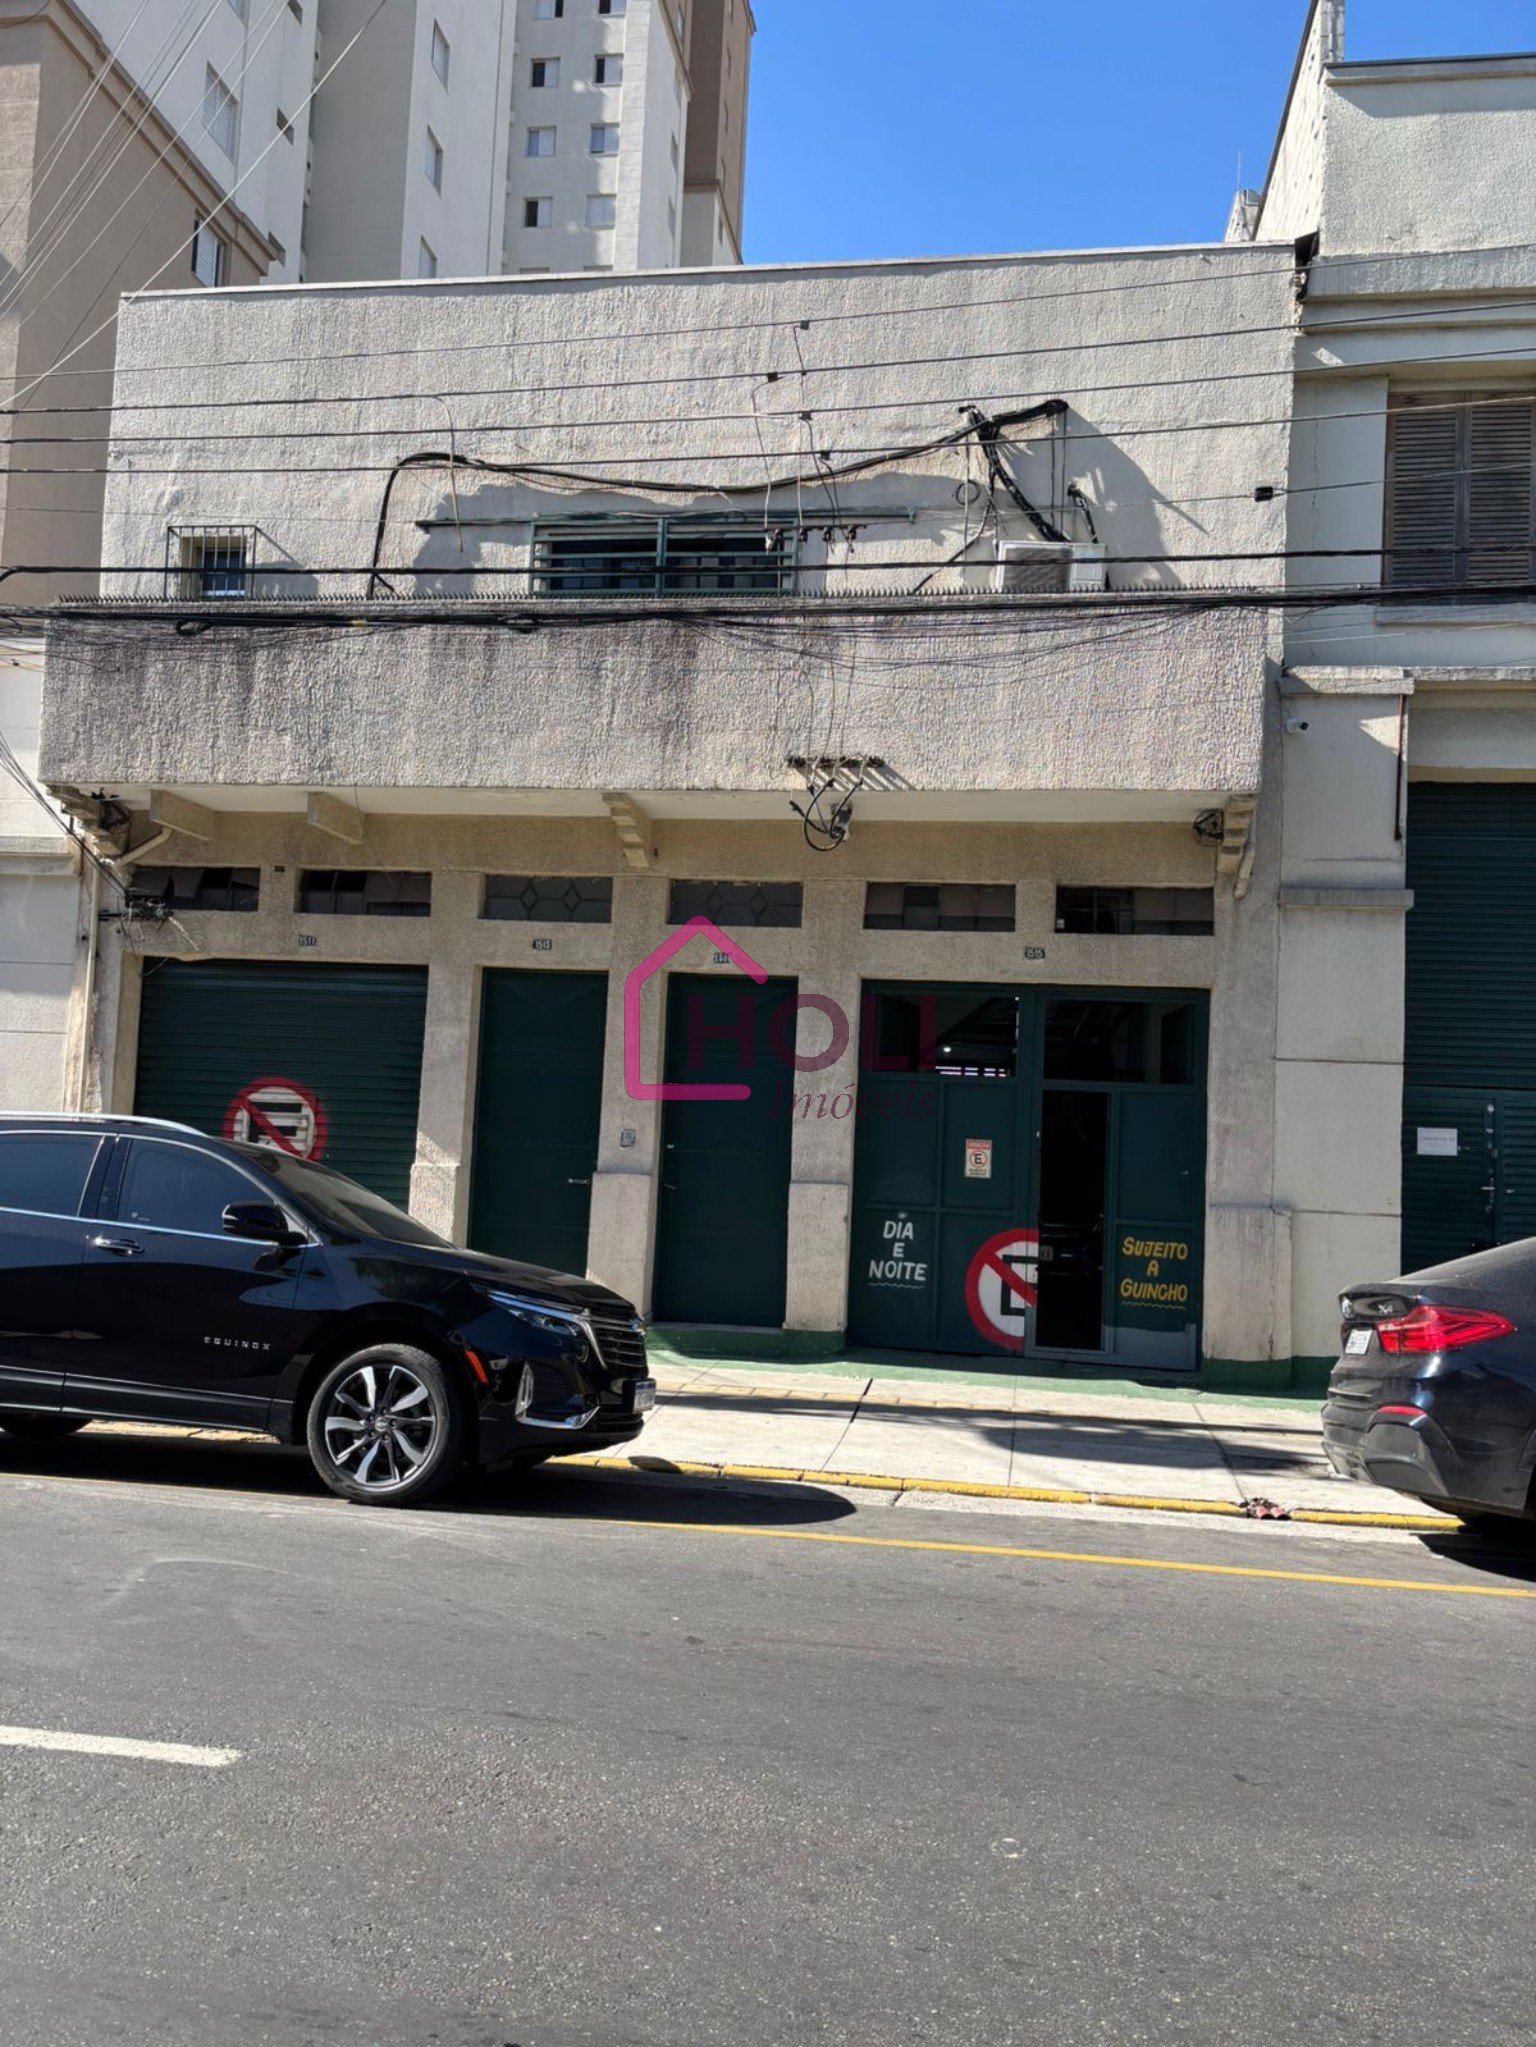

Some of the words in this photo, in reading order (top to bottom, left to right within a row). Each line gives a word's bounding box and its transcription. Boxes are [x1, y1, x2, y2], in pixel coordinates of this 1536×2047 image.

[883, 1220, 914, 1240] DIA
[893, 1242, 905, 1258] E
[1122, 1236, 1188, 1260] SUJEITO
[868, 1259, 928, 1281] NOITE
[1146, 1260, 1159, 1277] A
[1120, 1278, 1188, 1302] GUINCHO
[204, 1336, 270, 1351] EQUINOX
